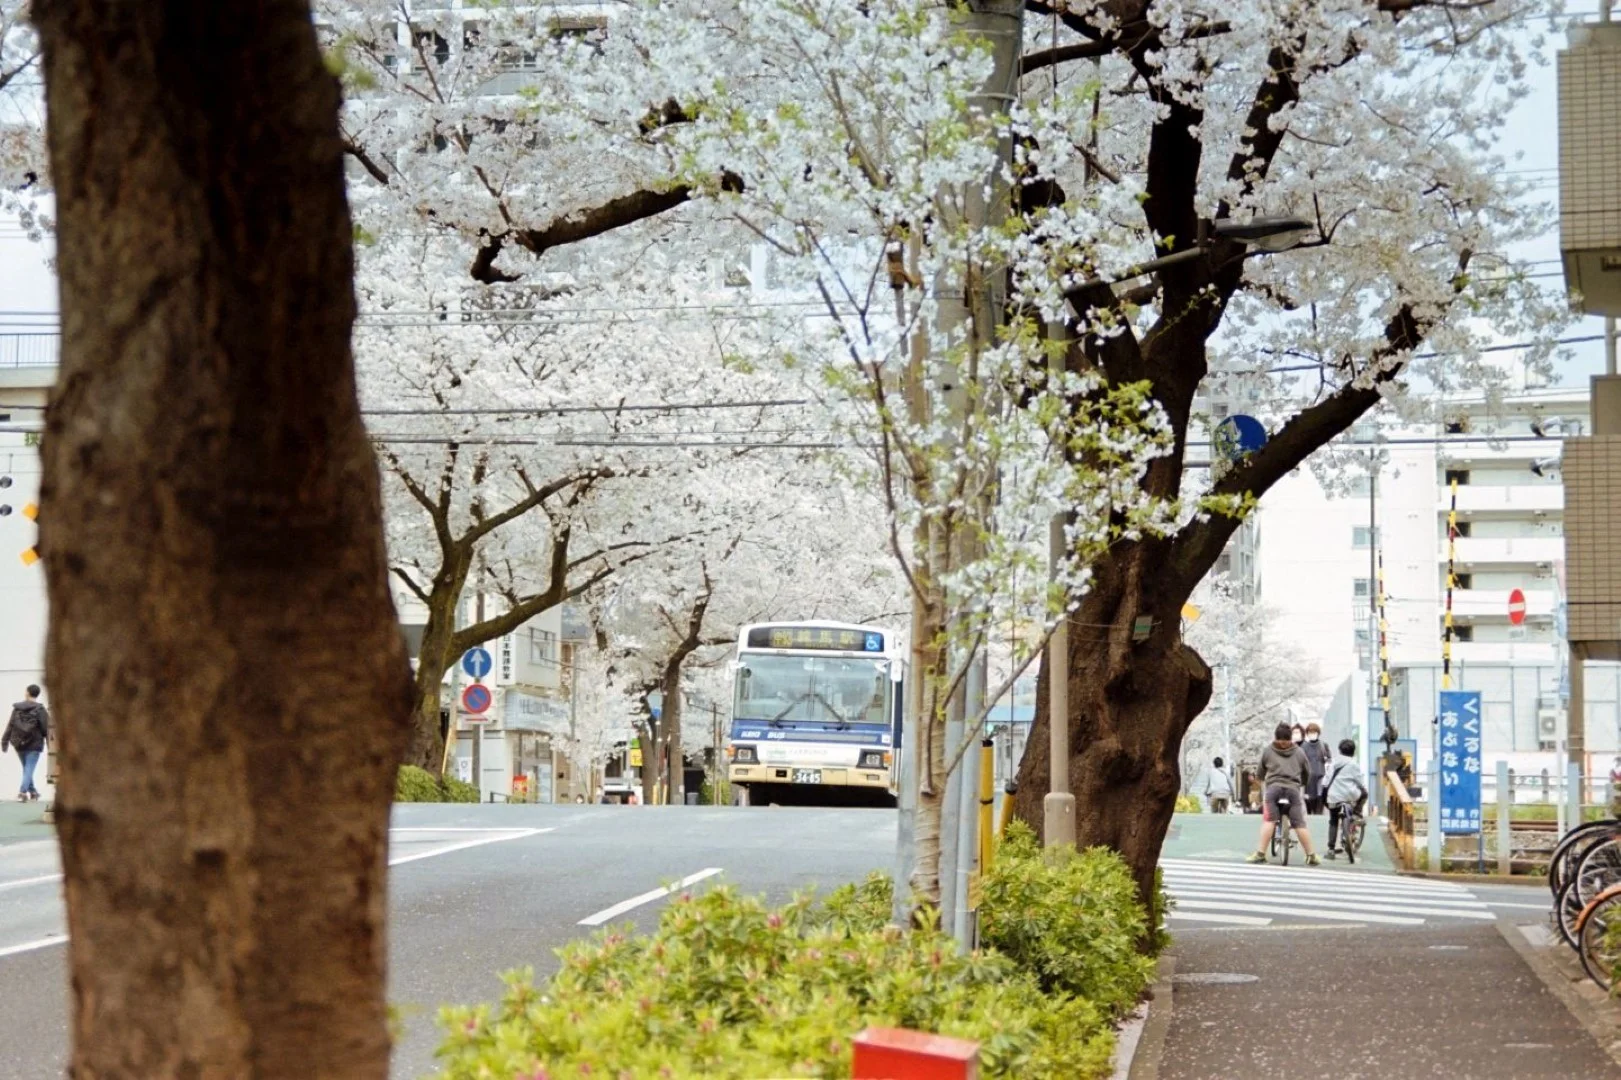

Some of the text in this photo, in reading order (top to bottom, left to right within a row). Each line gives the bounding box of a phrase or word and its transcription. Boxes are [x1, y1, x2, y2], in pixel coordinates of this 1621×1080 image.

[767, 731, 786, 739] BUS
[1442, 710, 1459, 786] あぶない
